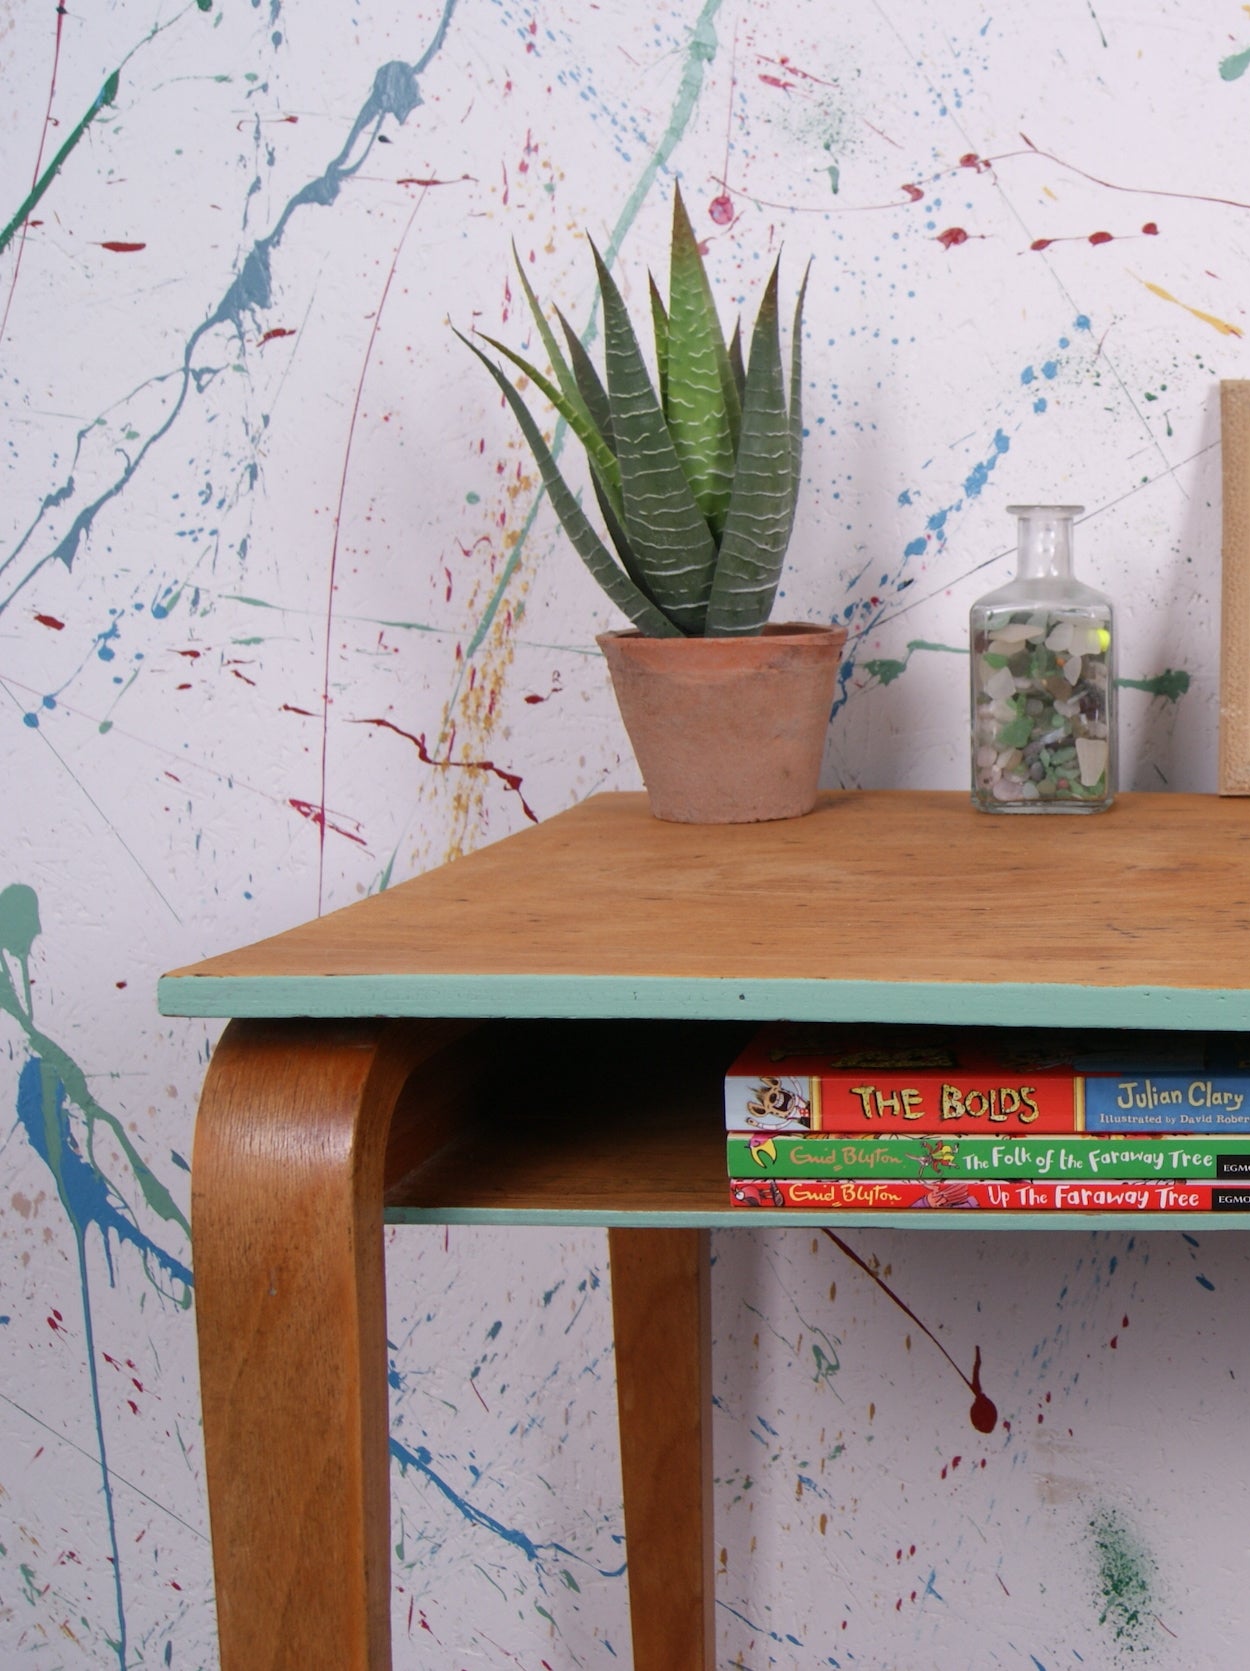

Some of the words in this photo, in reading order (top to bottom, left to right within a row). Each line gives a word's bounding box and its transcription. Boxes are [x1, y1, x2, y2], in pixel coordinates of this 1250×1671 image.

[850, 1084, 926, 1120] THE
[940, 1083, 1040, 1124] BOLDS
[1117, 1079, 1182, 1110] Julian
[1188, 1081, 1244, 1112] Clary
[1100, 1113, 1162, 1125] Illustrated
[1166, 1114, 1176, 1125] by
[1180, 1114, 1212, 1125] David
[789, 1146, 837, 1166] Enid
[843, 1147, 903, 1167] Blyton
[963, 1153, 989, 1171] The
[992, 1146, 1031, 1168] Folk
[1035, 1149, 1054, 1173] of
[1059, 1147, 1083, 1170] the
[1089, 1148, 1164, 1172] Faraway
[1168, 1150, 1213, 1170] Tree
[789, 1184, 836, 1202] Enid
[842, 1184, 903, 1203] Blyton
[987, 1185, 1010, 1208] Up
[1015, 1186, 1048, 1206] The
[1054, 1185, 1149, 1208] Faraway
[1155, 1187, 1199, 1209] Tree
